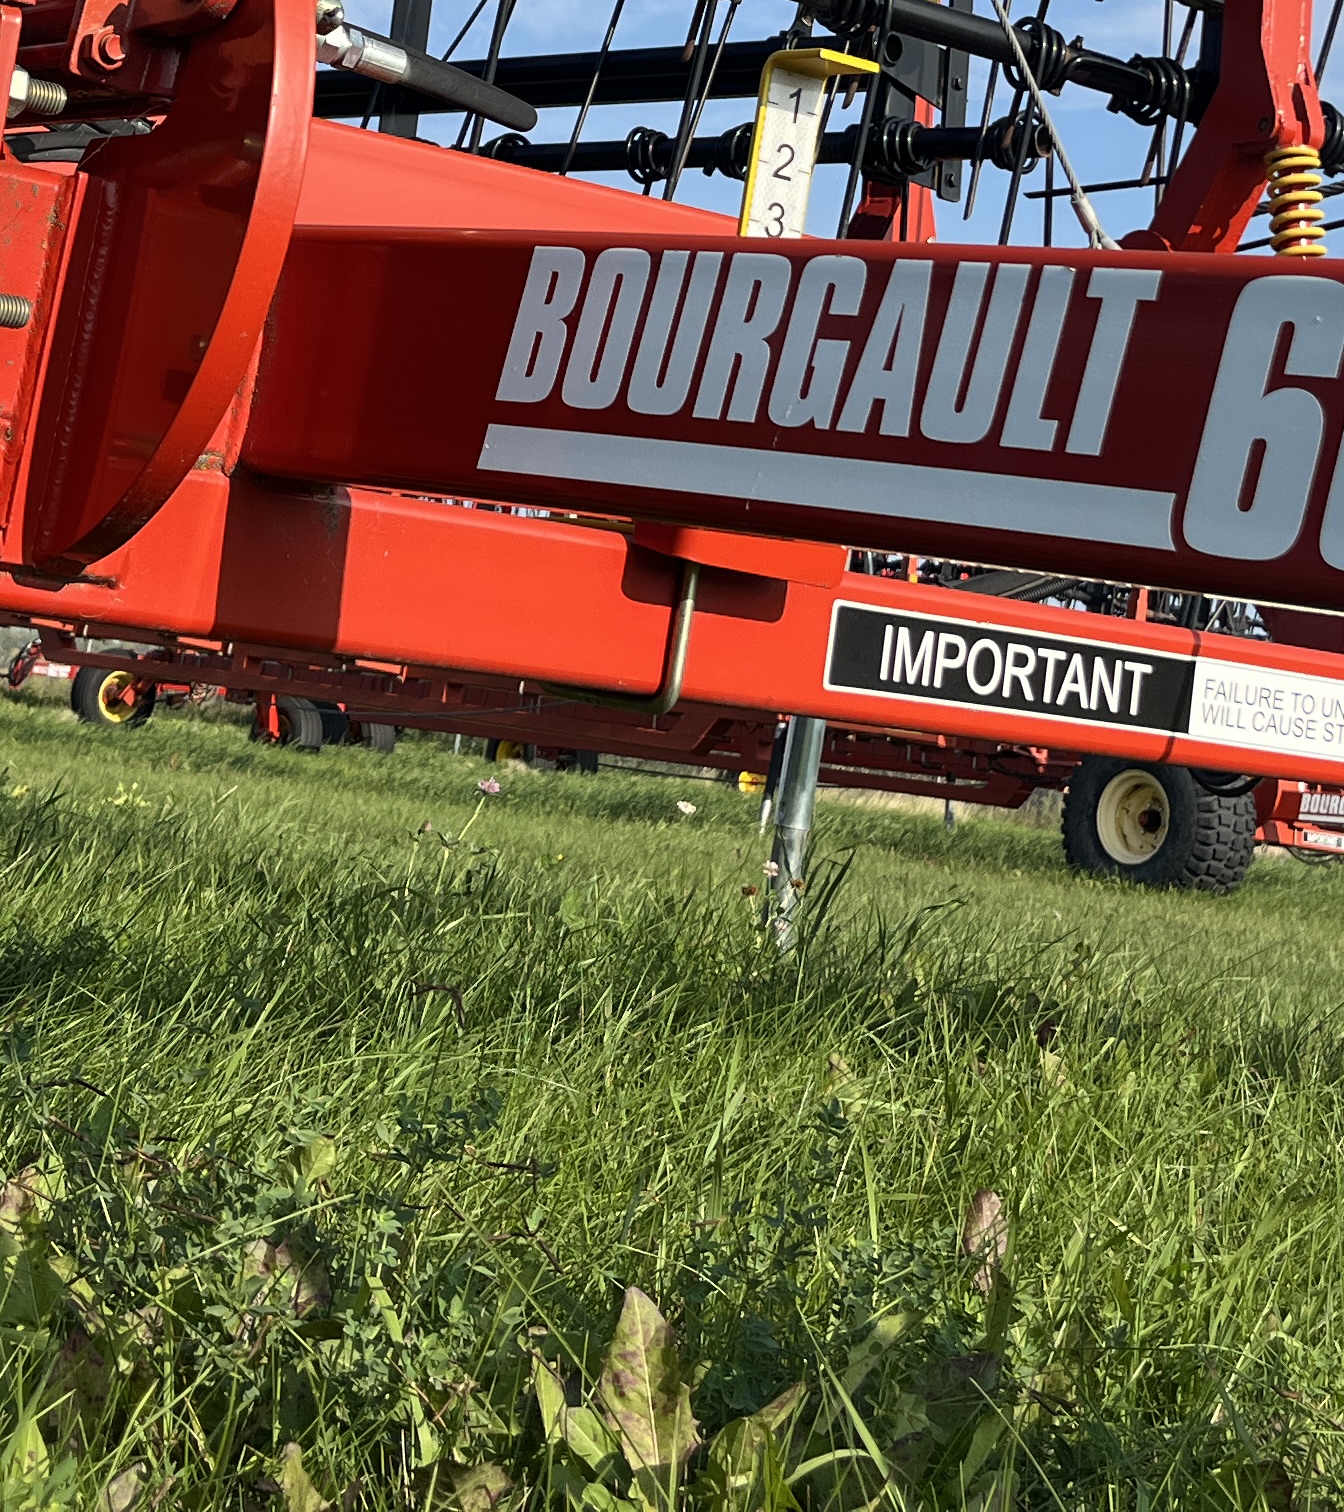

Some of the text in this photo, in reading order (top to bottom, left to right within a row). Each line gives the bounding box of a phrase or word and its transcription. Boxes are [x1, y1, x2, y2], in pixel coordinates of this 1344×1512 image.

[788, 88, 802, 123] 1
[772, 143, 795, 181] 2
[764, 202, 785, 238] 3
[494, 245, 1164, 456] BOURGAULT
[879, 624, 1154, 716] IMPORTANT
[1203, 678, 1285, 711] FAILURE
[1291, 691, 1316, 714] TO
[1202, 702, 1247, 730] WILL
[1252, 711, 1317, 740] CAUSE
